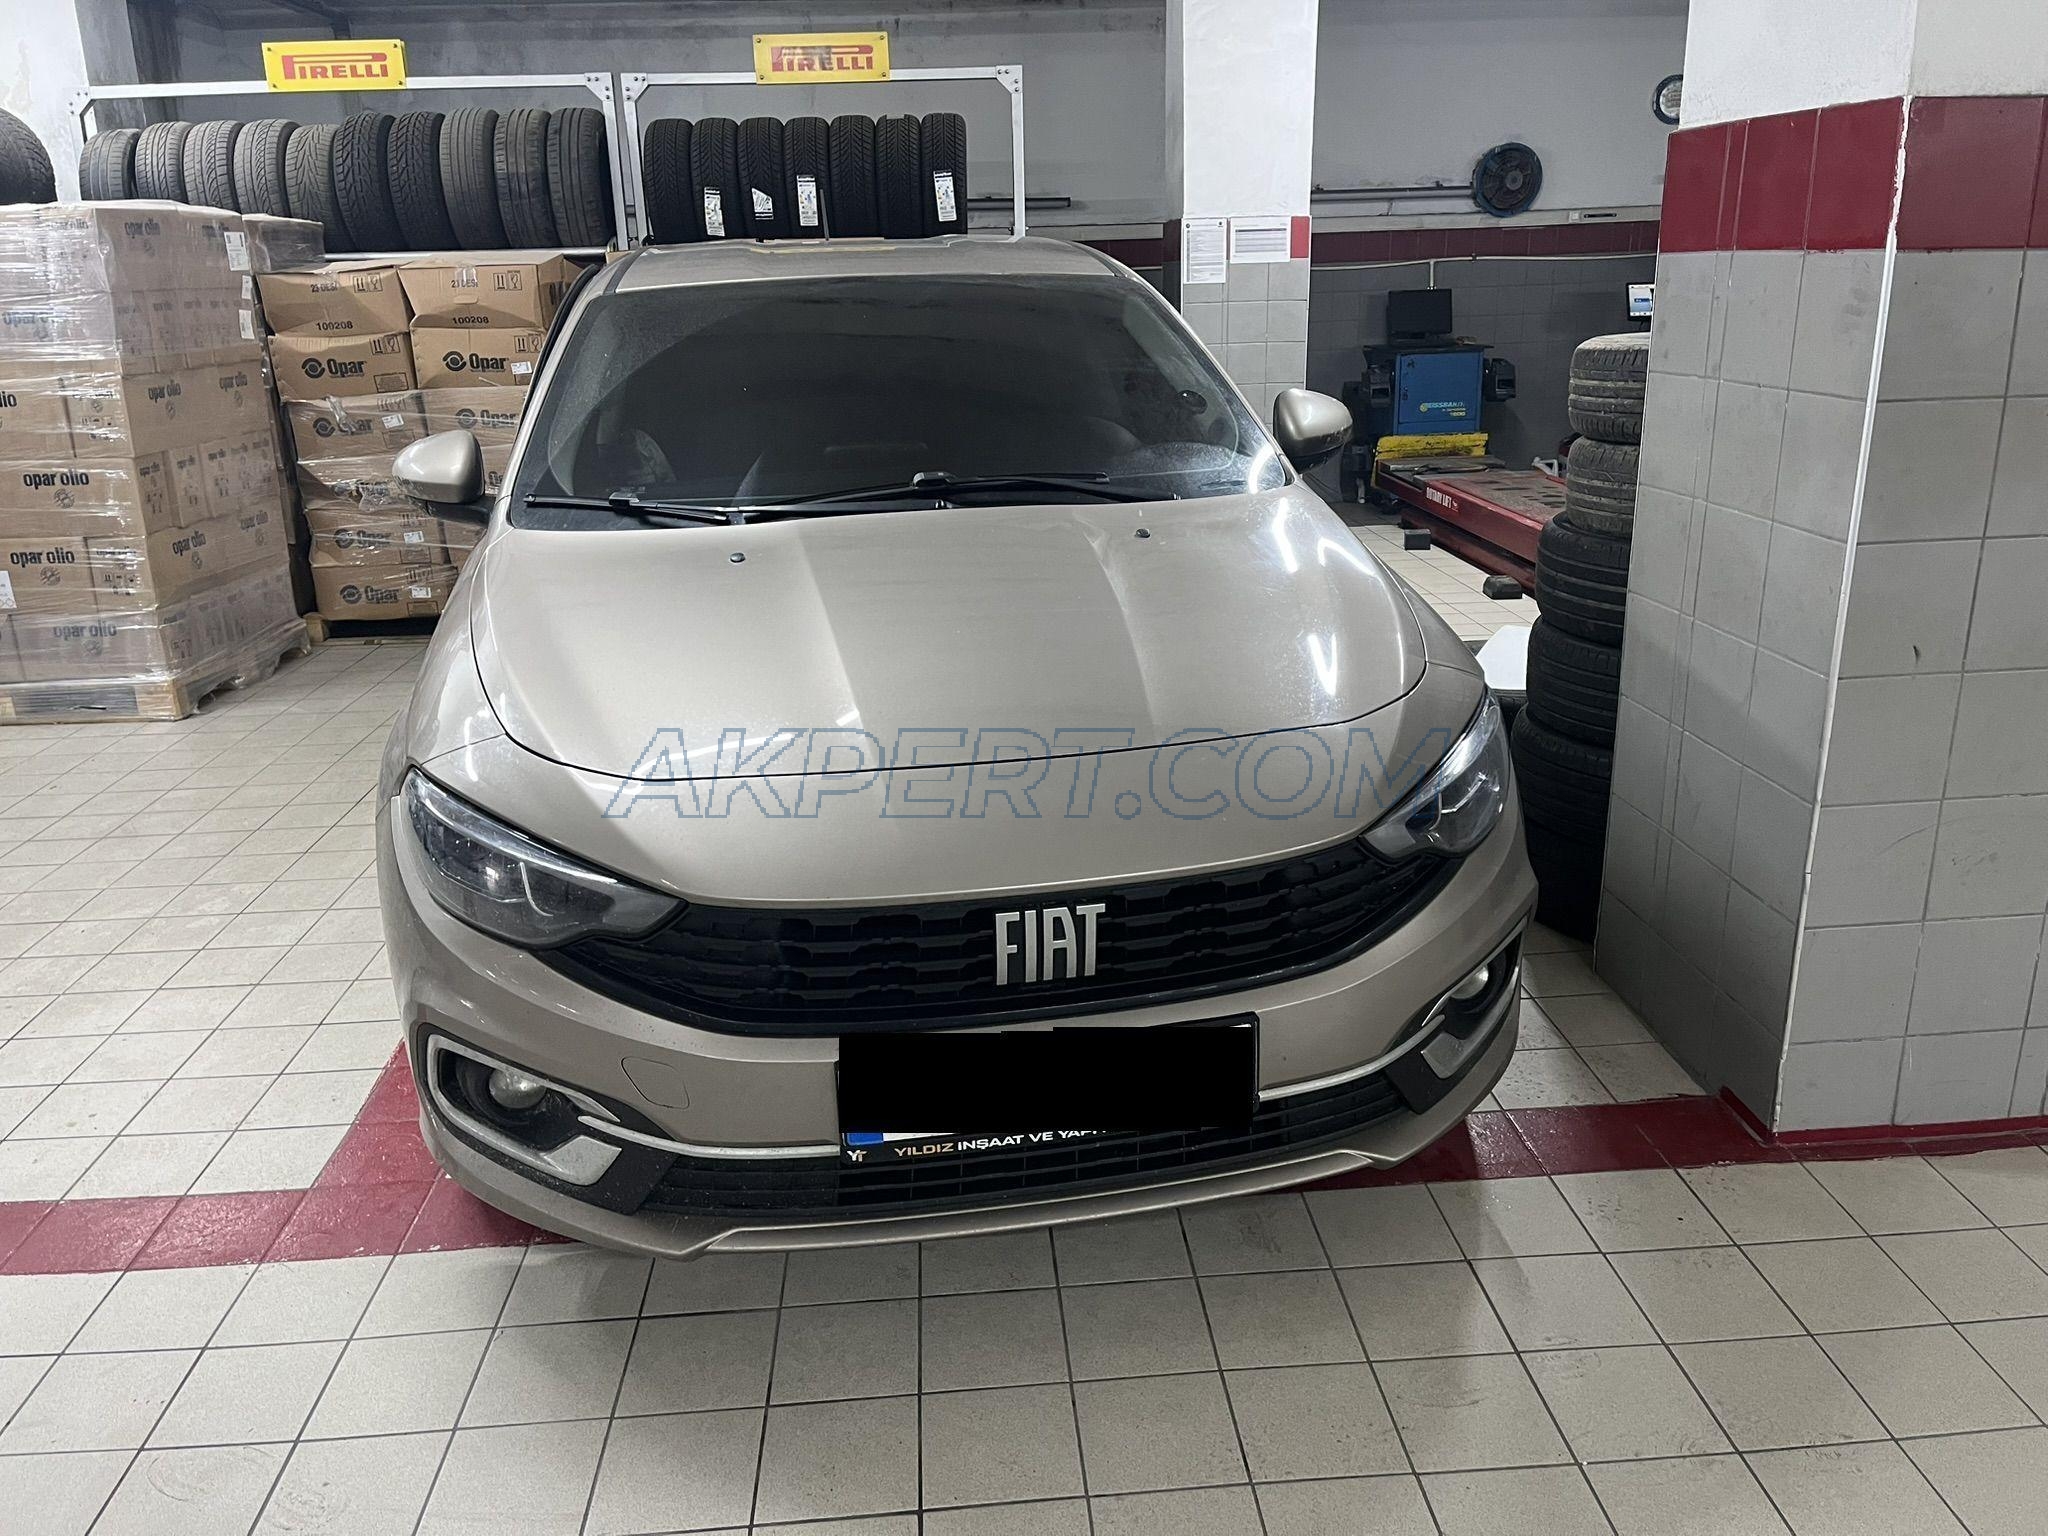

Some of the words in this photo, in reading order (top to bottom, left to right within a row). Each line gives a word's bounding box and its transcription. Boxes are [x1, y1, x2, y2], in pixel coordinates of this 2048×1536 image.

[281, 53, 388, 80] PIRELLI
[770, 45, 874, 72] PIRELLI
[316, 320, 353, 331] 100208
[453, 315, 489, 324] 100208
[326, 358, 367, 377] Opar
[469, 353, 509, 373] Opar
[0, 391, 17, 407] lio
[23, 472, 56, 489] opar
[61, 469, 90, 486] olio
[10, 550, 43, 568] opar
[47, 547, 75, 565] olio
[53, 624, 86, 641] opar
[995, 903, 1106, 986] FIAT
[894, 1143, 954, 1157] YILDIZ
[1029, 1131, 1053, 1142] VE
